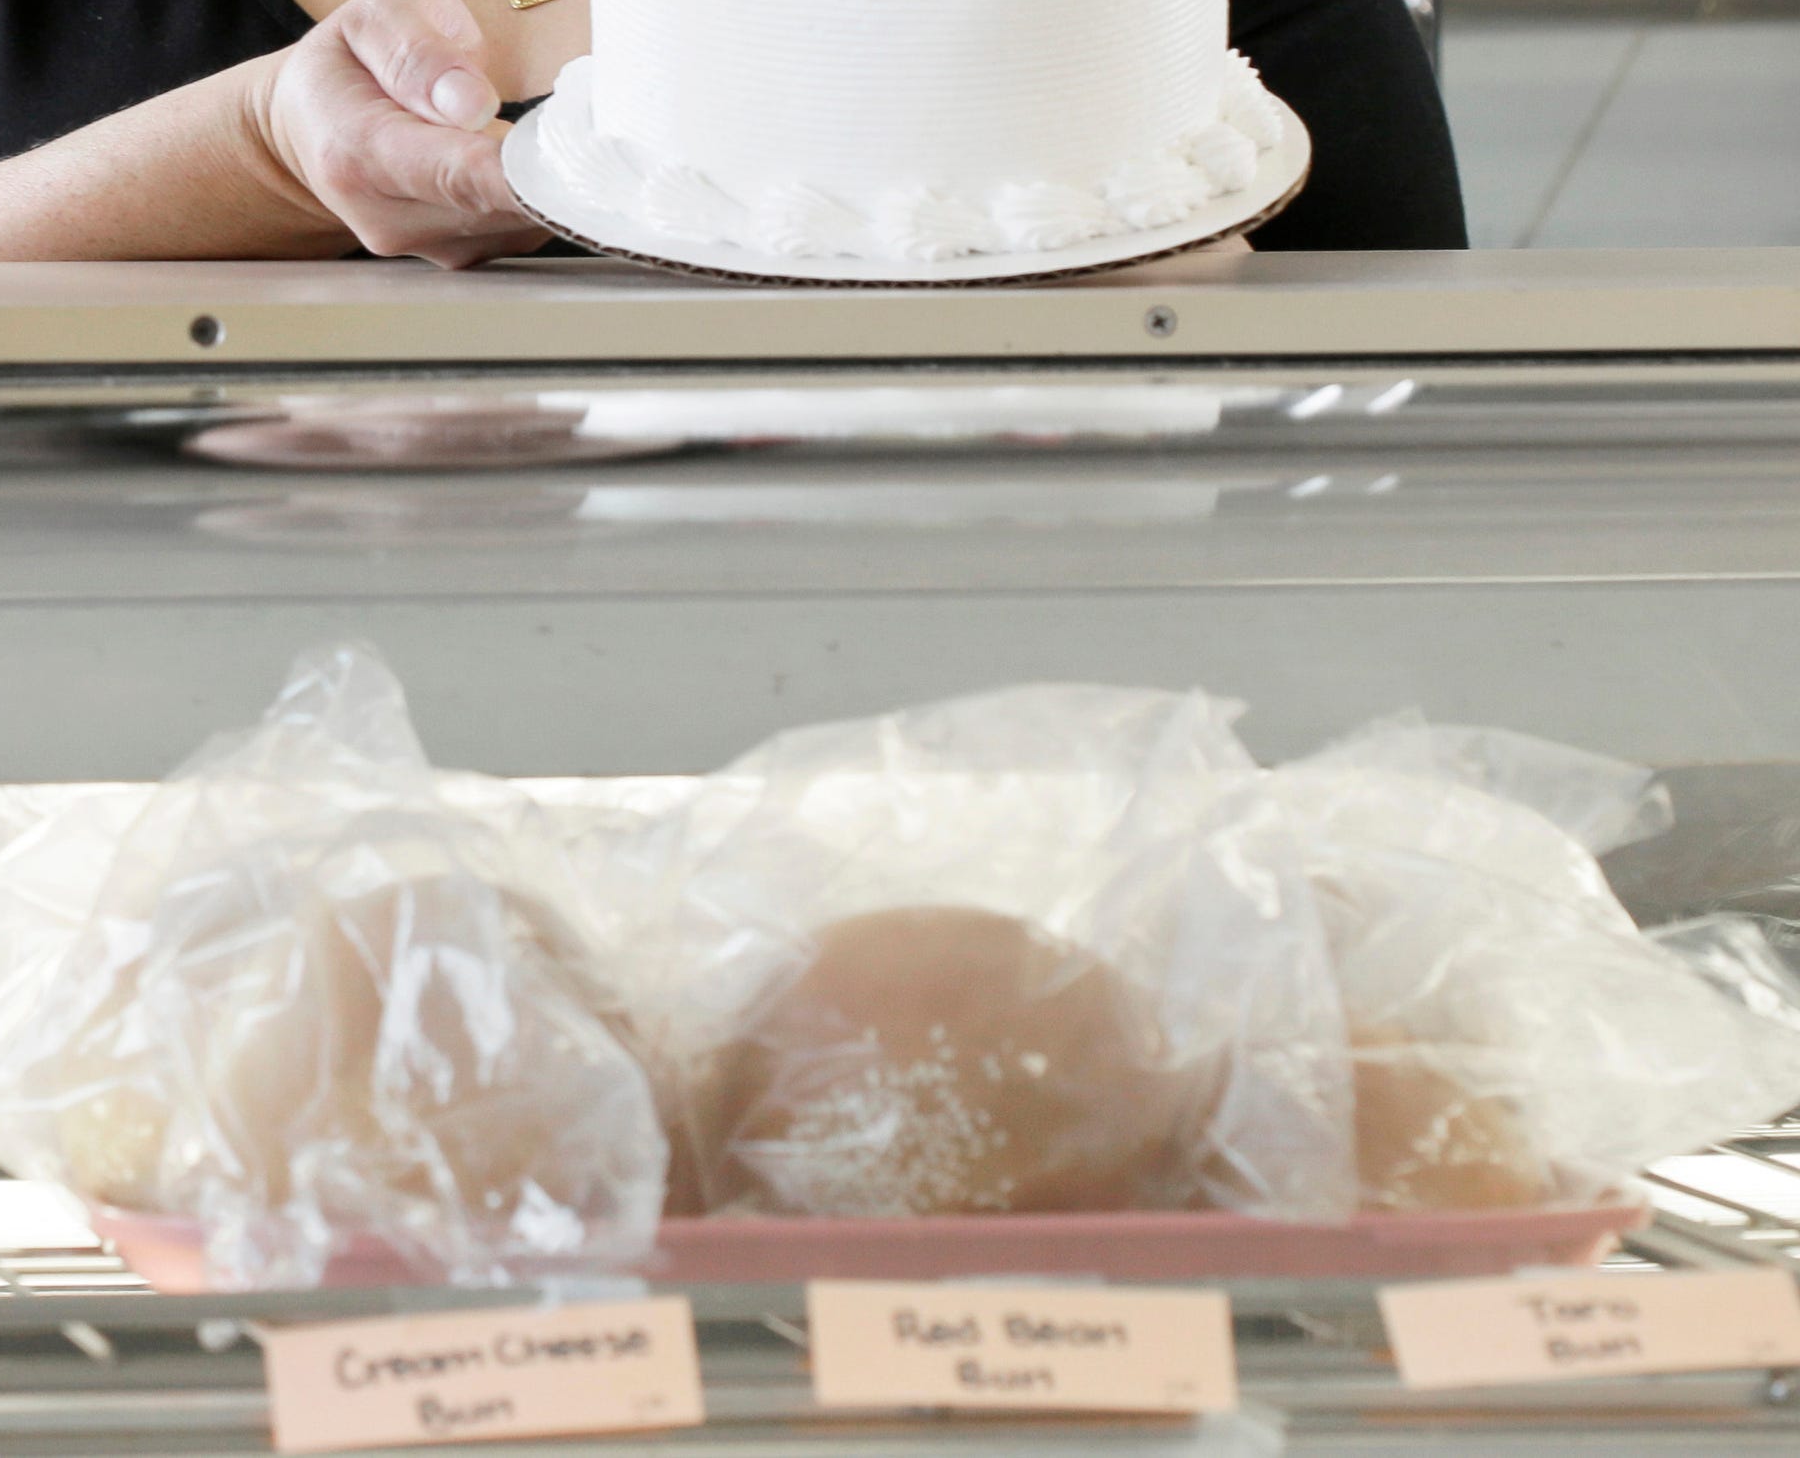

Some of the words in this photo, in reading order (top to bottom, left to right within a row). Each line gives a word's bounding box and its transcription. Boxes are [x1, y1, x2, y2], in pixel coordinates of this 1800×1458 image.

[891, 1308, 981, 1345] Red
[1002, 1311, 1130, 1349] Bean
[333, 1346, 485, 1390] Cream
[494, 1326, 651, 1368] Cheese
[955, 1358, 1055, 1391] Bun
[416, 1394, 517, 1434] Bun
